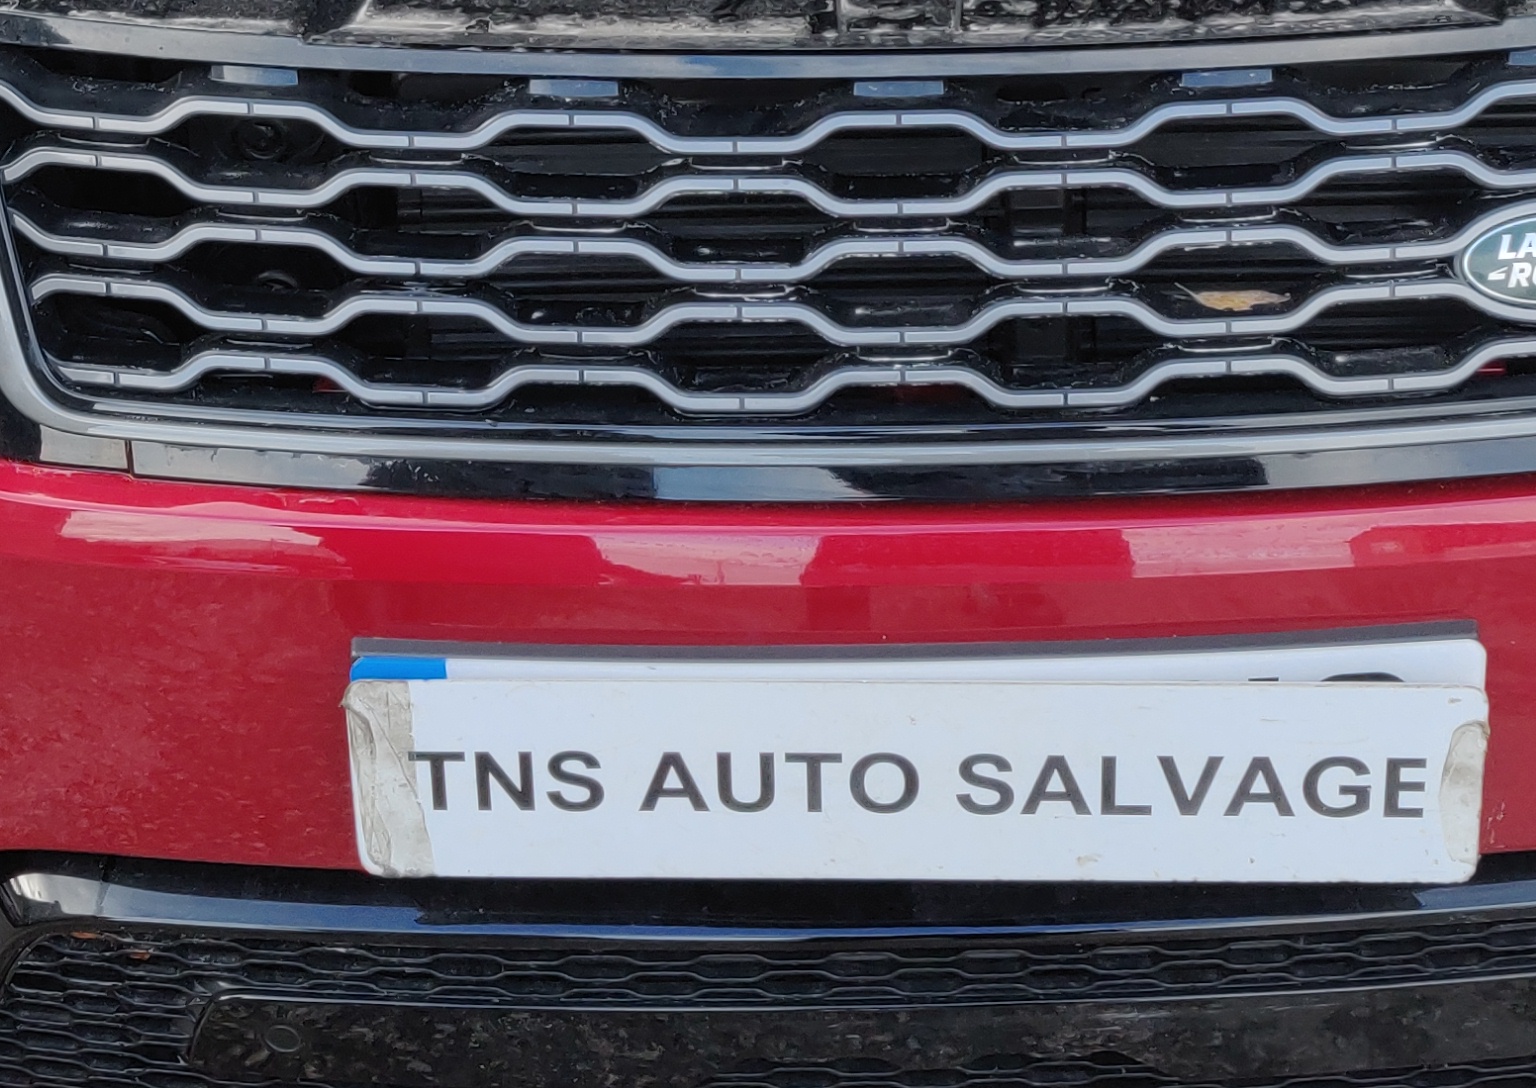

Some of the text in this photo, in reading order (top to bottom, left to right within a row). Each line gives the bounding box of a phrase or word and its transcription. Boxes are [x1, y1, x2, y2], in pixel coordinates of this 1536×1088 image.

[407, 750, 1428, 819] TNS AUTO SALVAGE
